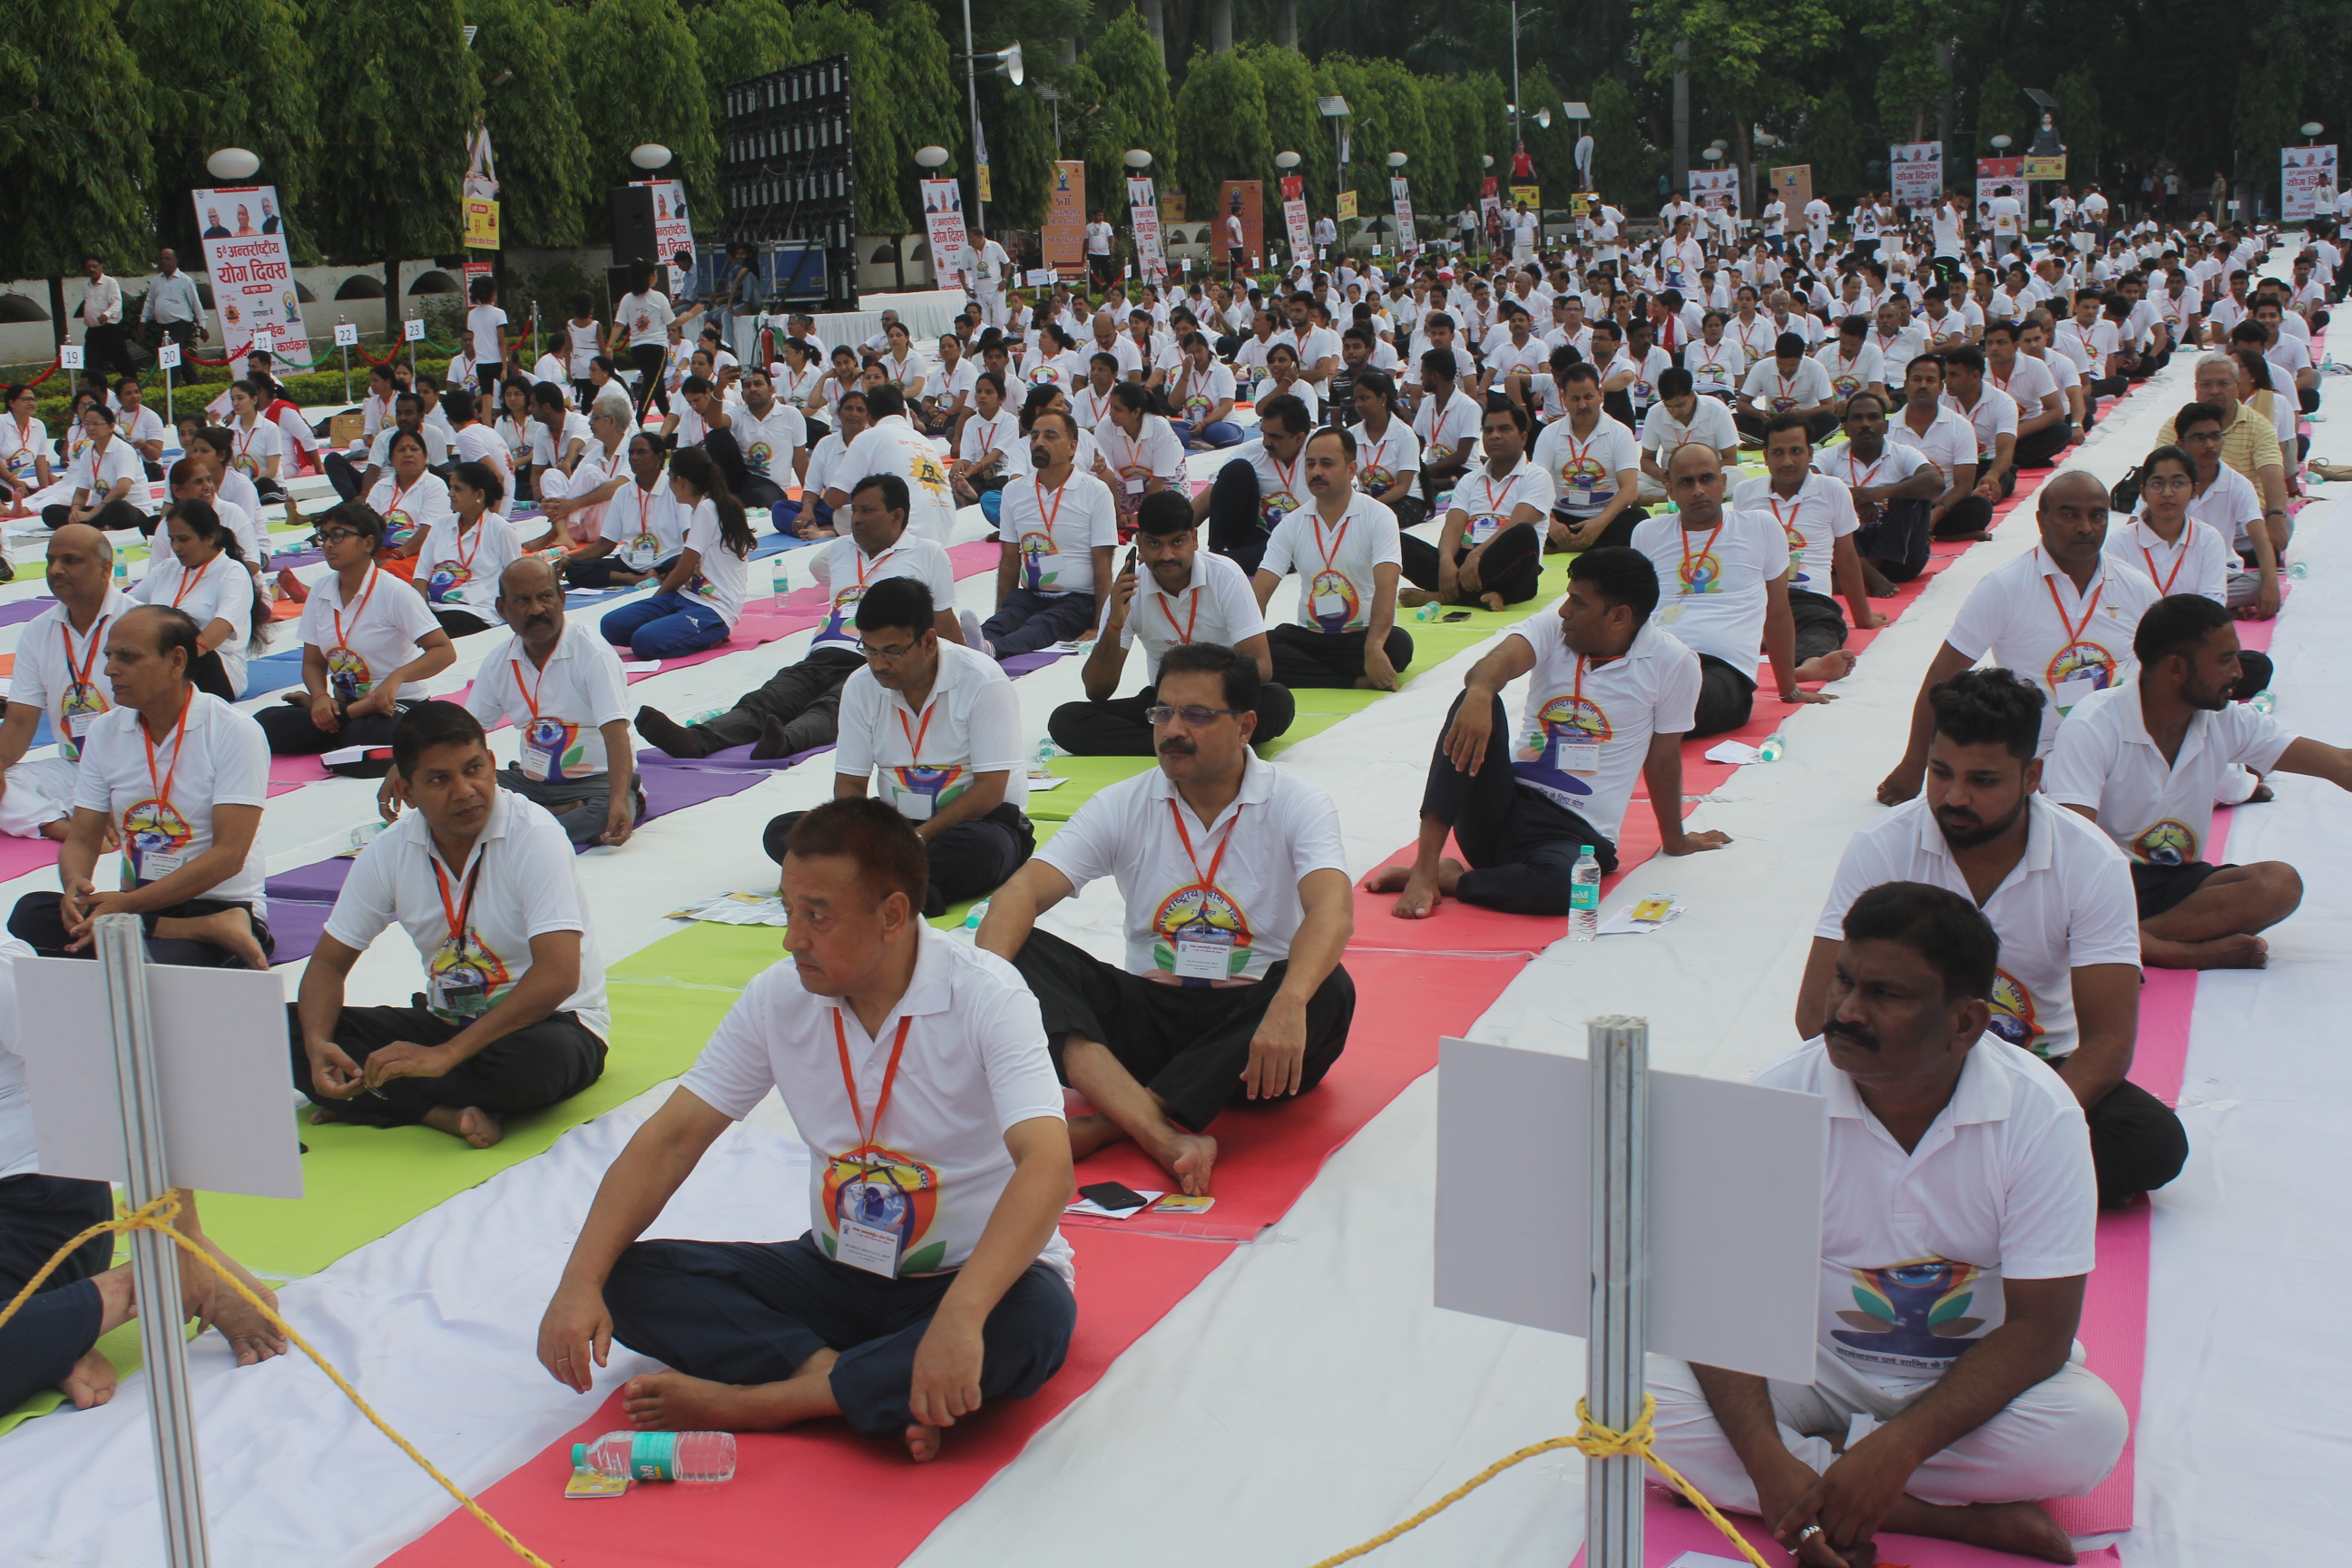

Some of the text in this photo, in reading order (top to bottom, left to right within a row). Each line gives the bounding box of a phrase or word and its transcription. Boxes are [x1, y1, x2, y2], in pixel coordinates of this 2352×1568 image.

[1896, 171, 1938, 181] योग दिवस
[2287, 178, 2306, 187] योग
[933, 227, 965, 243] योग दिवस
[228, 240, 279, 258] अन्तर्राष्ट्रीय
[217, 259, 288, 284] योग दिवस
[339, 329, 352, 341] 22
[408, 325, 420, 337] 23
[258, 337, 268, 349] 21
[66, 351, 78, 364] 19
[163, 350, 176, 364] 20
[2006, 982, 2028, 1014] दिवस
[1930, 1360, 1941, 1368] के
